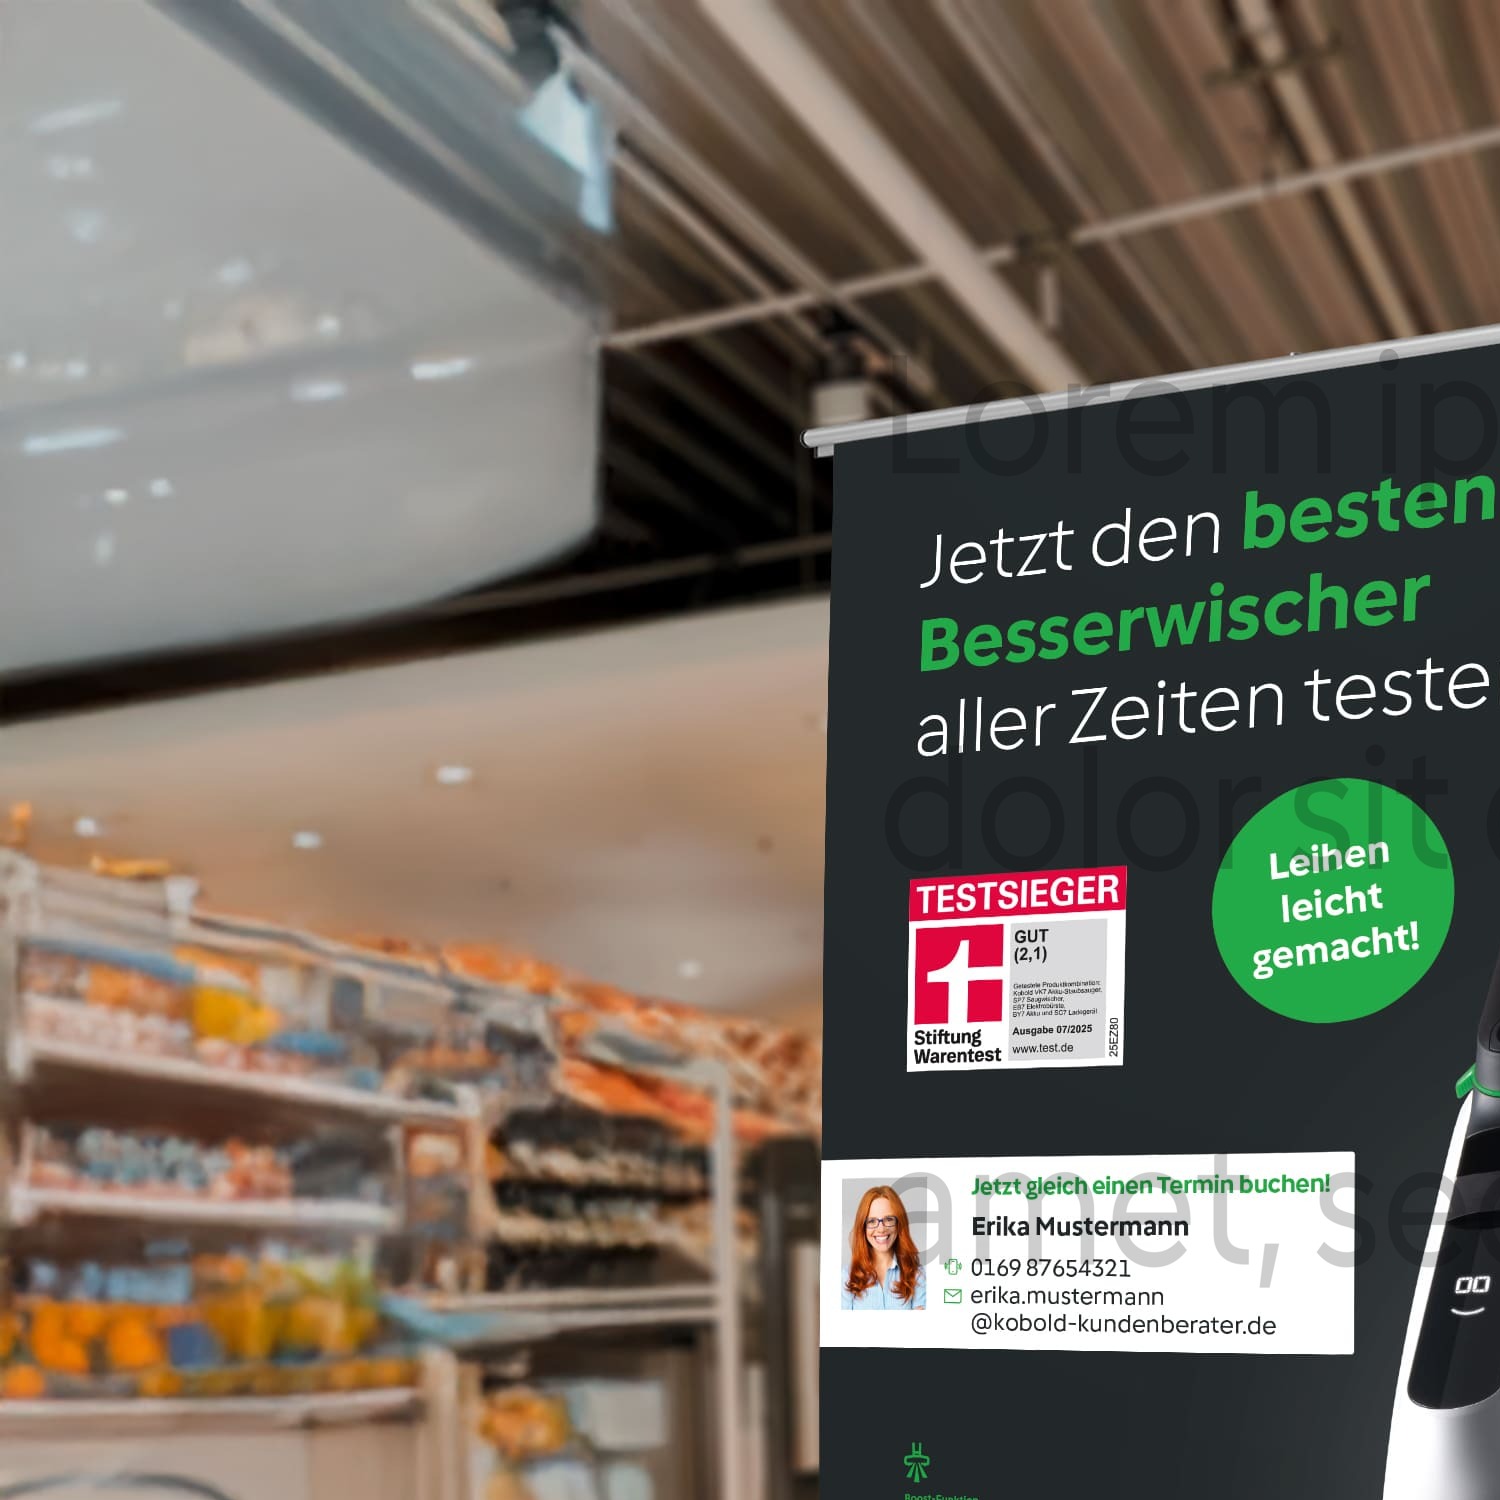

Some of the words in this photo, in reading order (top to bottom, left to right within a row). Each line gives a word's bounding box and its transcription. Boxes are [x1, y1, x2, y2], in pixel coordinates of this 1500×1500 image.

[919, 519, 1075, 588] Jetzt
[1090, 507, 1222, 567] den
[1242, 472, 1497, 551] besten
[918, 570, 1432, 674] Besserwischer
[915, 698, 1056, 759] aller
[1067, 679, 1284, 745] Zeiten
[1269, 838, 1391, 882] Leihen
[916, 873, 1121, 914] TESTSIEGER
[1281, 883, 1383, 923] leicht
[1014, 929, 1049, 944] GUT
[1013, 946, 1048, 964] (2,1)
[1253, 920, 1421, 980] gemacht!
[914, 1028, 982, 1047] Stiftung
[1012, 1026, 1054, 1036] Ausgabe
[1056, 1024, 1093, 1034] 07/2025
[1108, 1017, 1119, 1057] 25EZ80
[914, 1047, 1002, 1065] Warentest
[1012, 1043, 1074, 1054] www.test.de
[971, 1176, 1022, 1197] Jetzt
[1026, 1175, 1088, 1200] gleich
[1092, 1176, 1153, 1195] einen
[1157, 1175, 1234, 1195] Termin
[1239, 1173, 1331, 1194] buchen!
[972, 1216, 1030, 1237] Erika
[1036, 1216, 1189, 1237] Mustermann
[971, 1259, 1022, 1278] 0169
[1026, 1258, 1132, 1278] 87654321
[970, 1286, 1165, 1306] erika.mustermann
[970, 1313, 1277, 1337] @kobold-kundenberater.de
